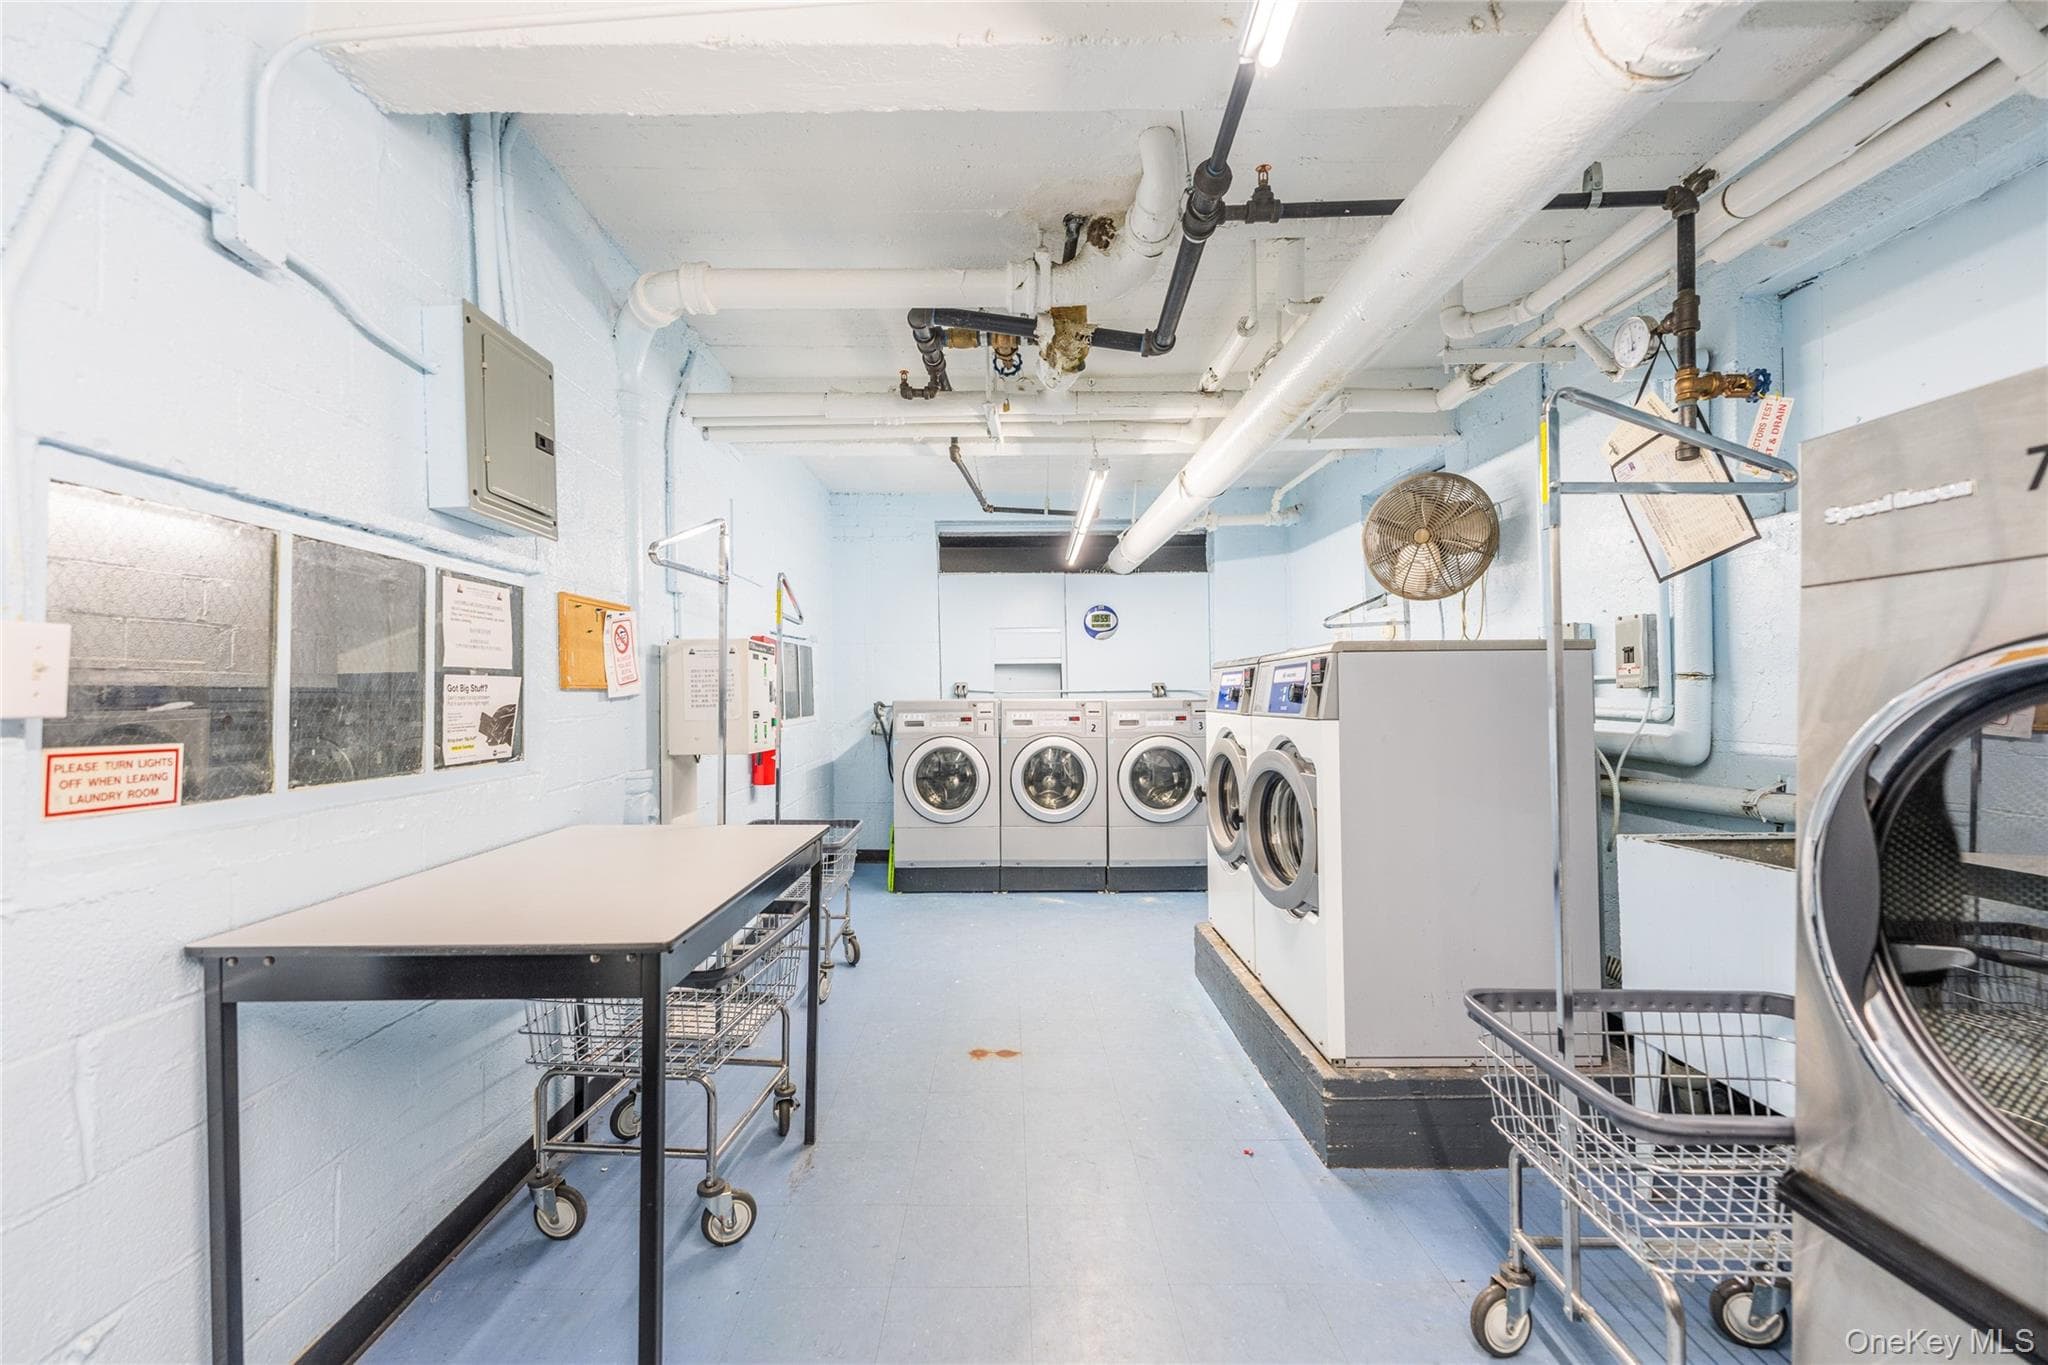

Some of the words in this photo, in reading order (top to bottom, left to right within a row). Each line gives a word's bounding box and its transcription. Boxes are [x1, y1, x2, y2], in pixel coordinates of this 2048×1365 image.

[1762, 403, 1773, 421] TEST
[1772, 403, 1787, 435] DRAIN
[2027, 443, 2048, 491] 7
[447, 683, 459, 692] Got
[460, 683, 470, 694] Big
[470, 683, 489, 692] Stuff?
[1091, 724, 1097, 733] 2
[1198, 721, 1204, 731] 3
[54, 761, 99, 774] PLEASE
[105, 760, 133, 770] TURN
[138, 757, 174, 768] LIGHTS
[59, 779, 82, 790] OFF
[88, 775, 121, 787] WHEN
[126, 772, 169, 784] LEAVING
[68, 790, 123, 805] LAUNDRY
[127, 787, 159, 799] ROOM
